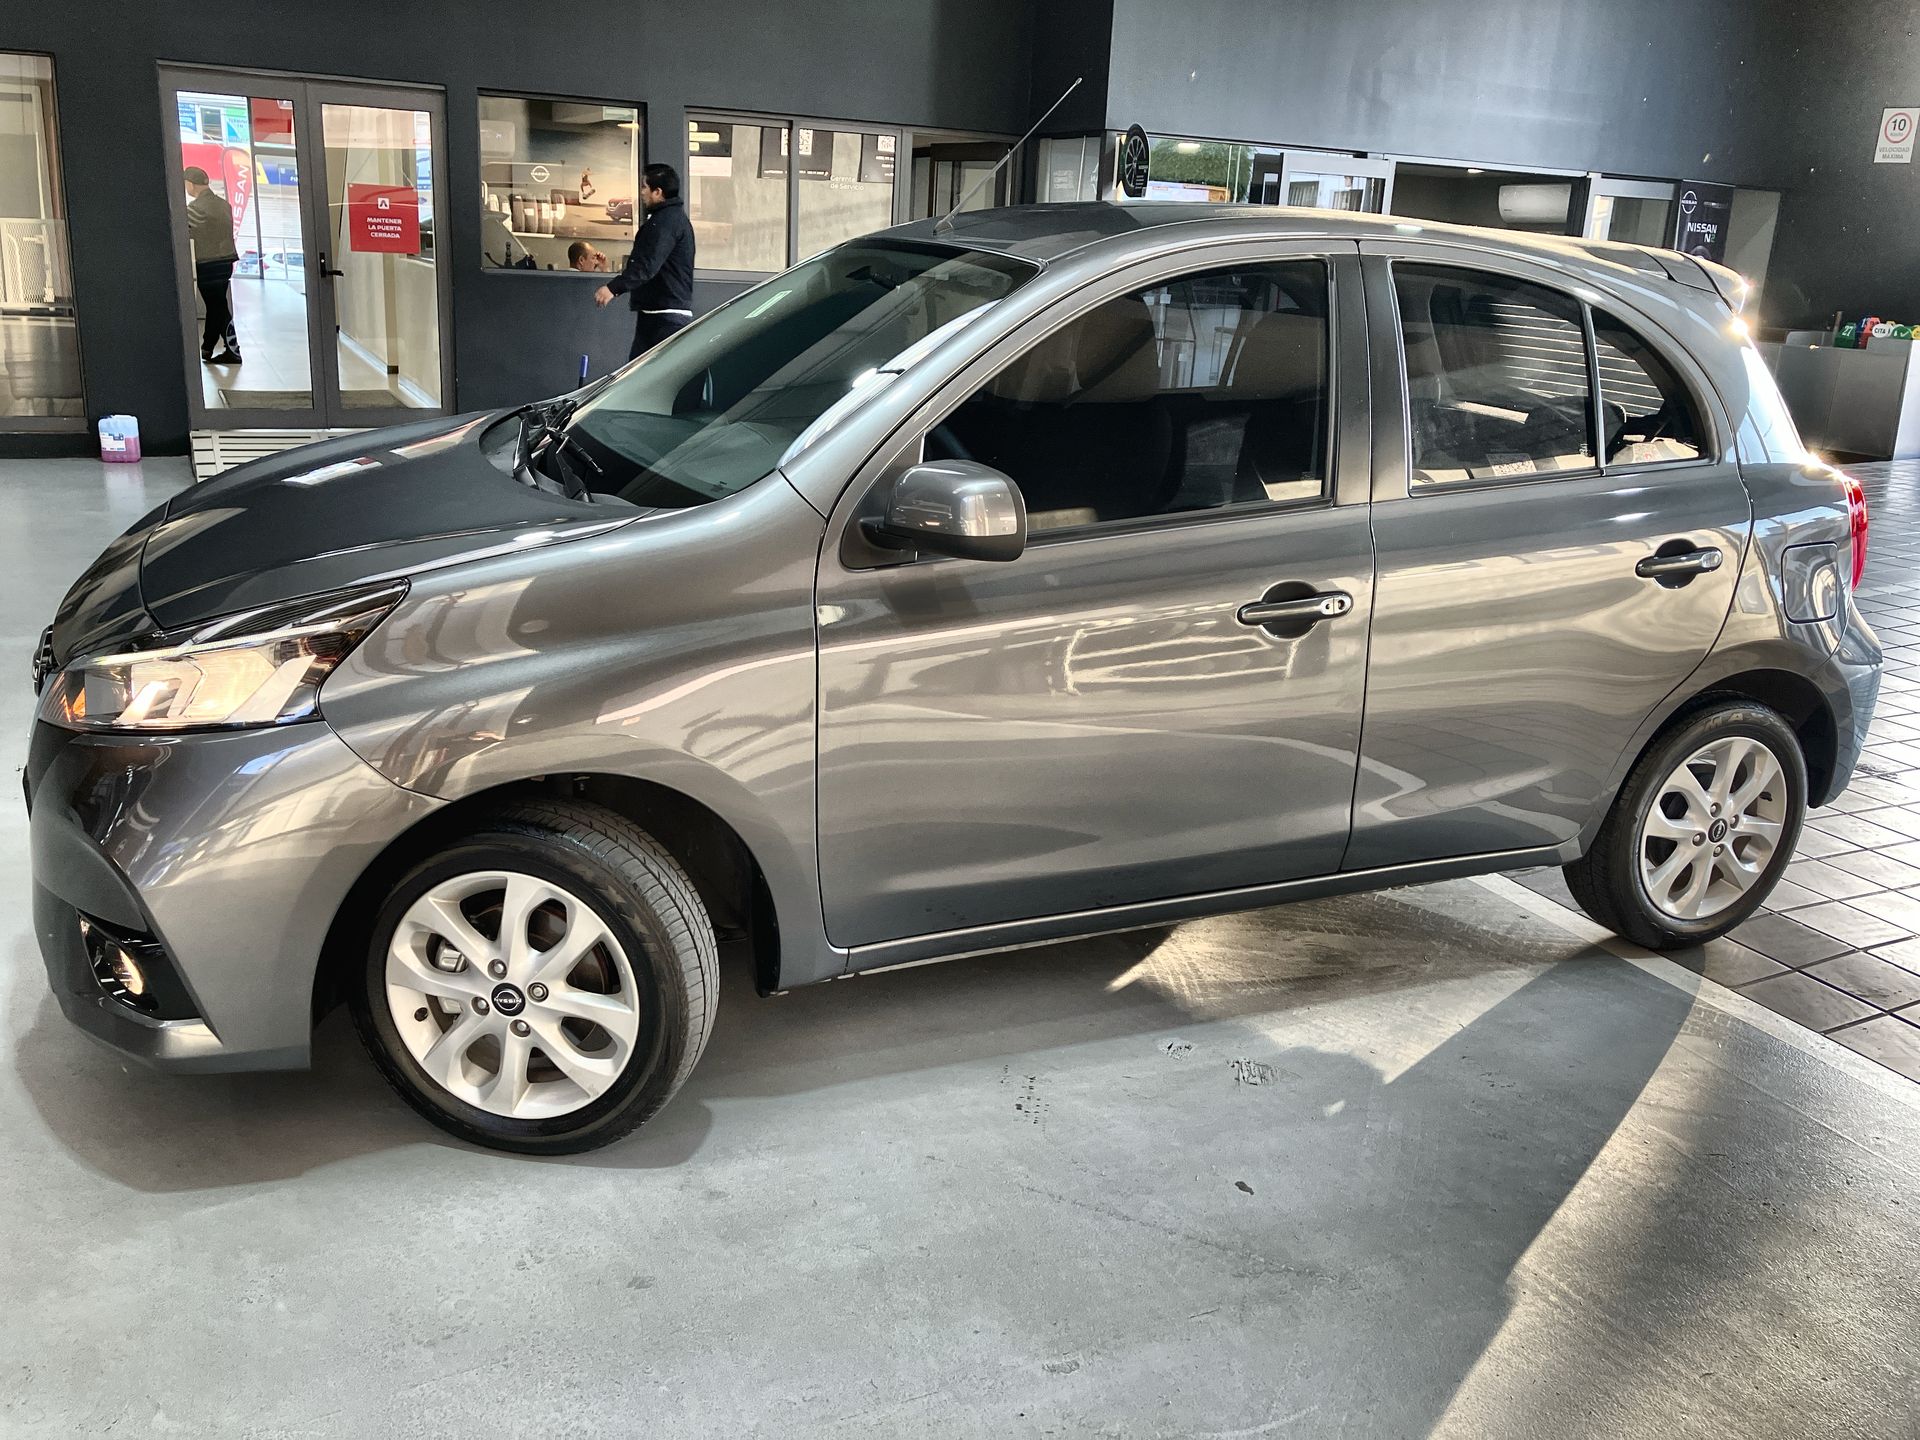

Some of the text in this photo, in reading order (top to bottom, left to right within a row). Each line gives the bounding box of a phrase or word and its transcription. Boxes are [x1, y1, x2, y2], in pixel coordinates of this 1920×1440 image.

[1891, 118, 1906, 131] 10
[1687, 222, 1718, 234] NISSAN
[1841, 325, 1854, 337] 27
